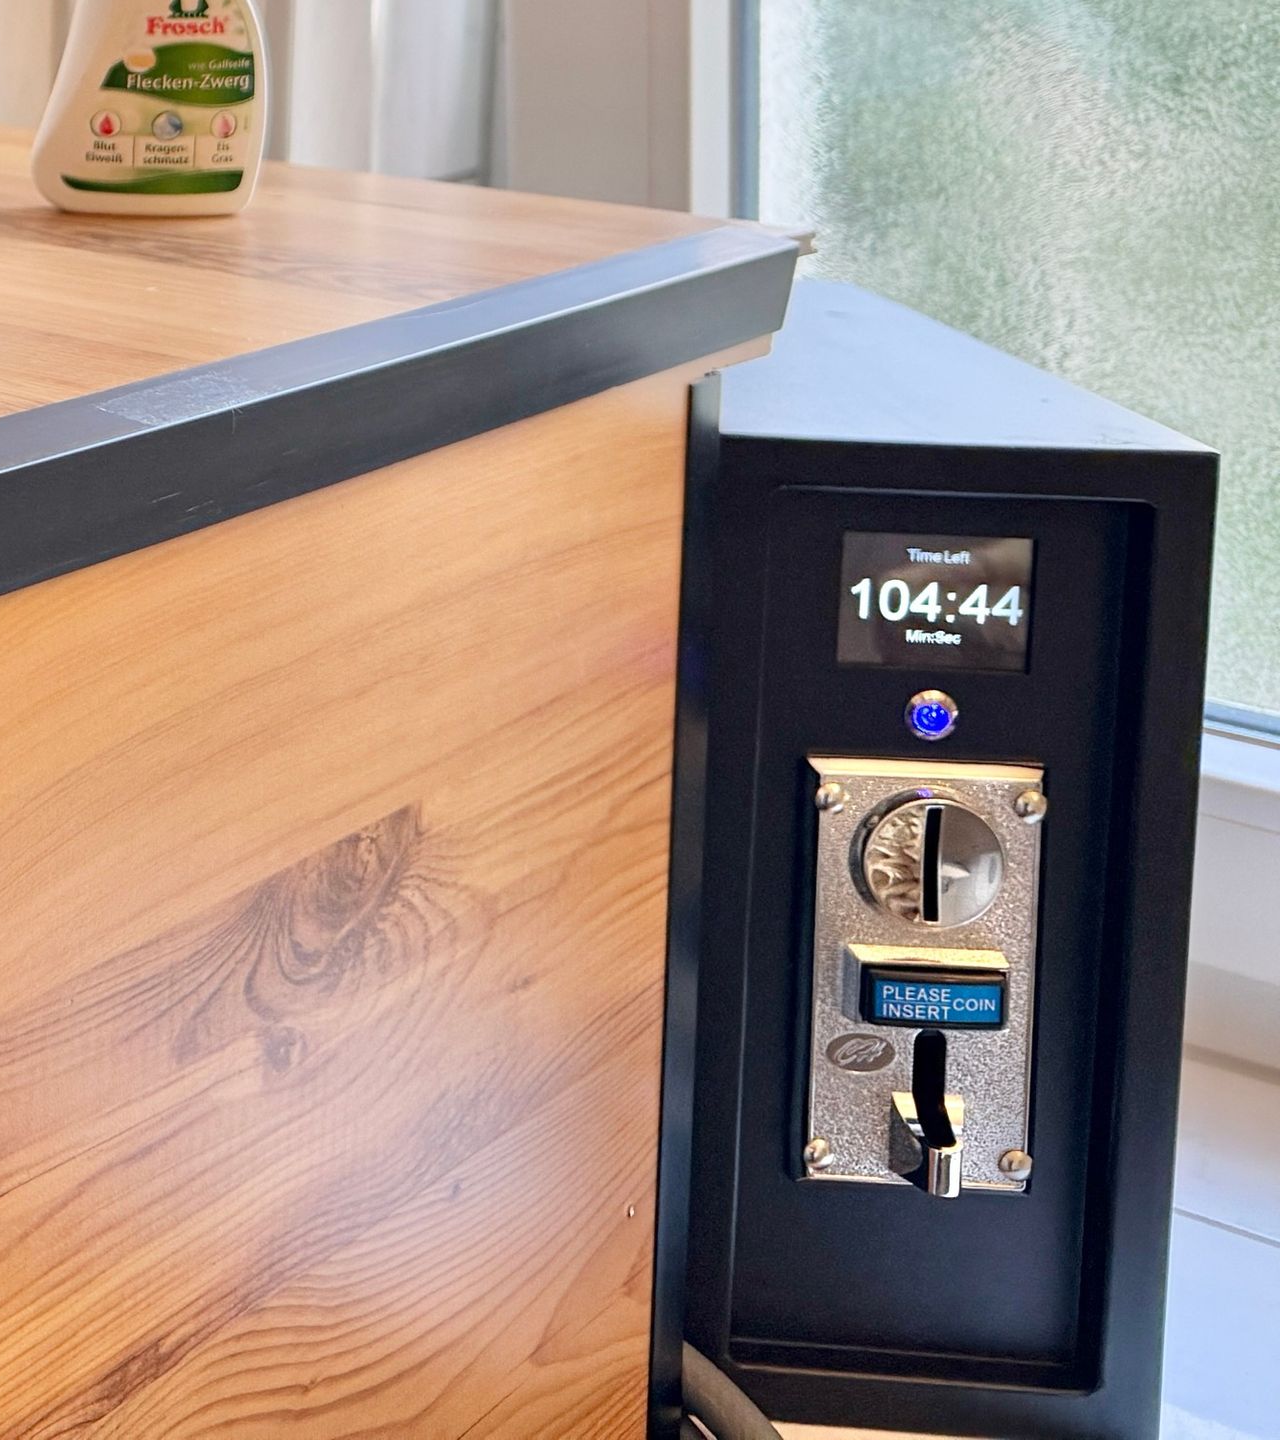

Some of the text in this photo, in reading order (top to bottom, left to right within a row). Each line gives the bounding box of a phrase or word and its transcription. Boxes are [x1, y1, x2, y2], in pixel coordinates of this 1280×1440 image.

[146, 15, 225, 36] Frosch
[126, 73, 250, 90] Flecken-Zwerg
[907, 547, 972, 566] Time Left
[850, 577, 1024, 627] 104:44
[882, 985, 952, 1004] PLEASE
[882, 997, 997, 1021] INSERT COIN
